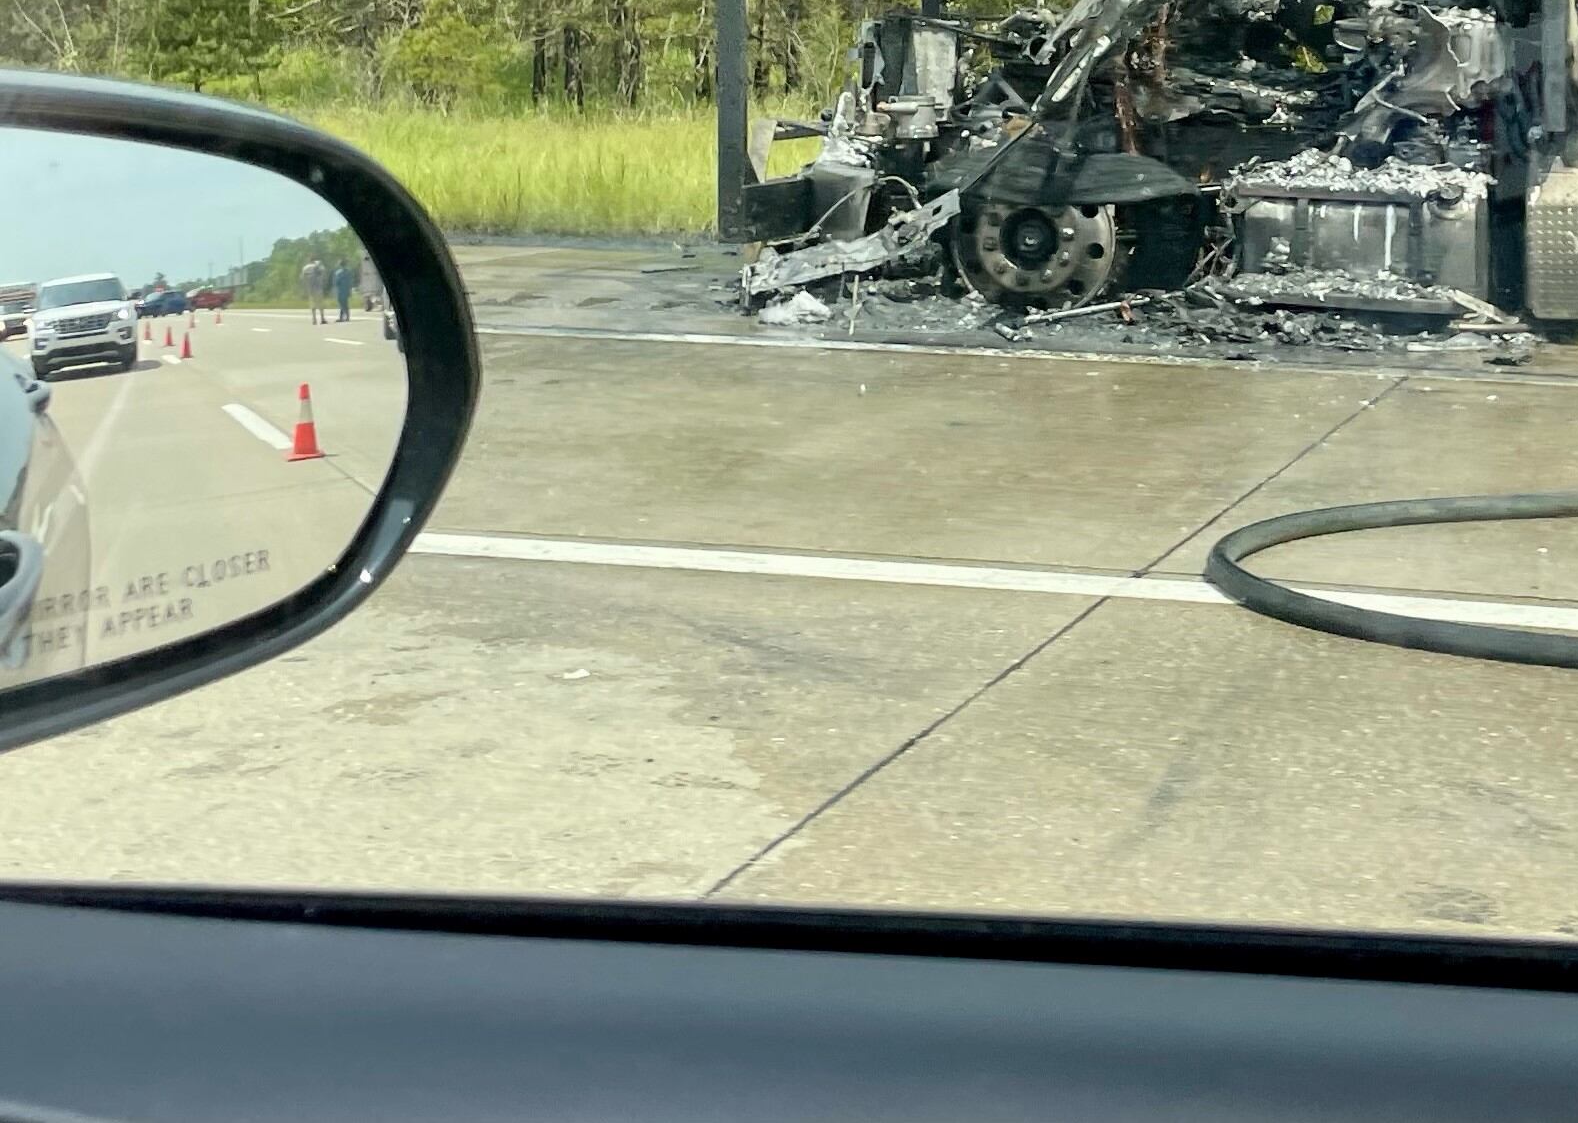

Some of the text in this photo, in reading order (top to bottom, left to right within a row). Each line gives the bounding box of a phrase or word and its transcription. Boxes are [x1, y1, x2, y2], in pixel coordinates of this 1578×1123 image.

[122, 573, 168, 601] ARE
[184, 549, 270, 588] CLOSER
[102, 597, 194, 636] APPEAR
